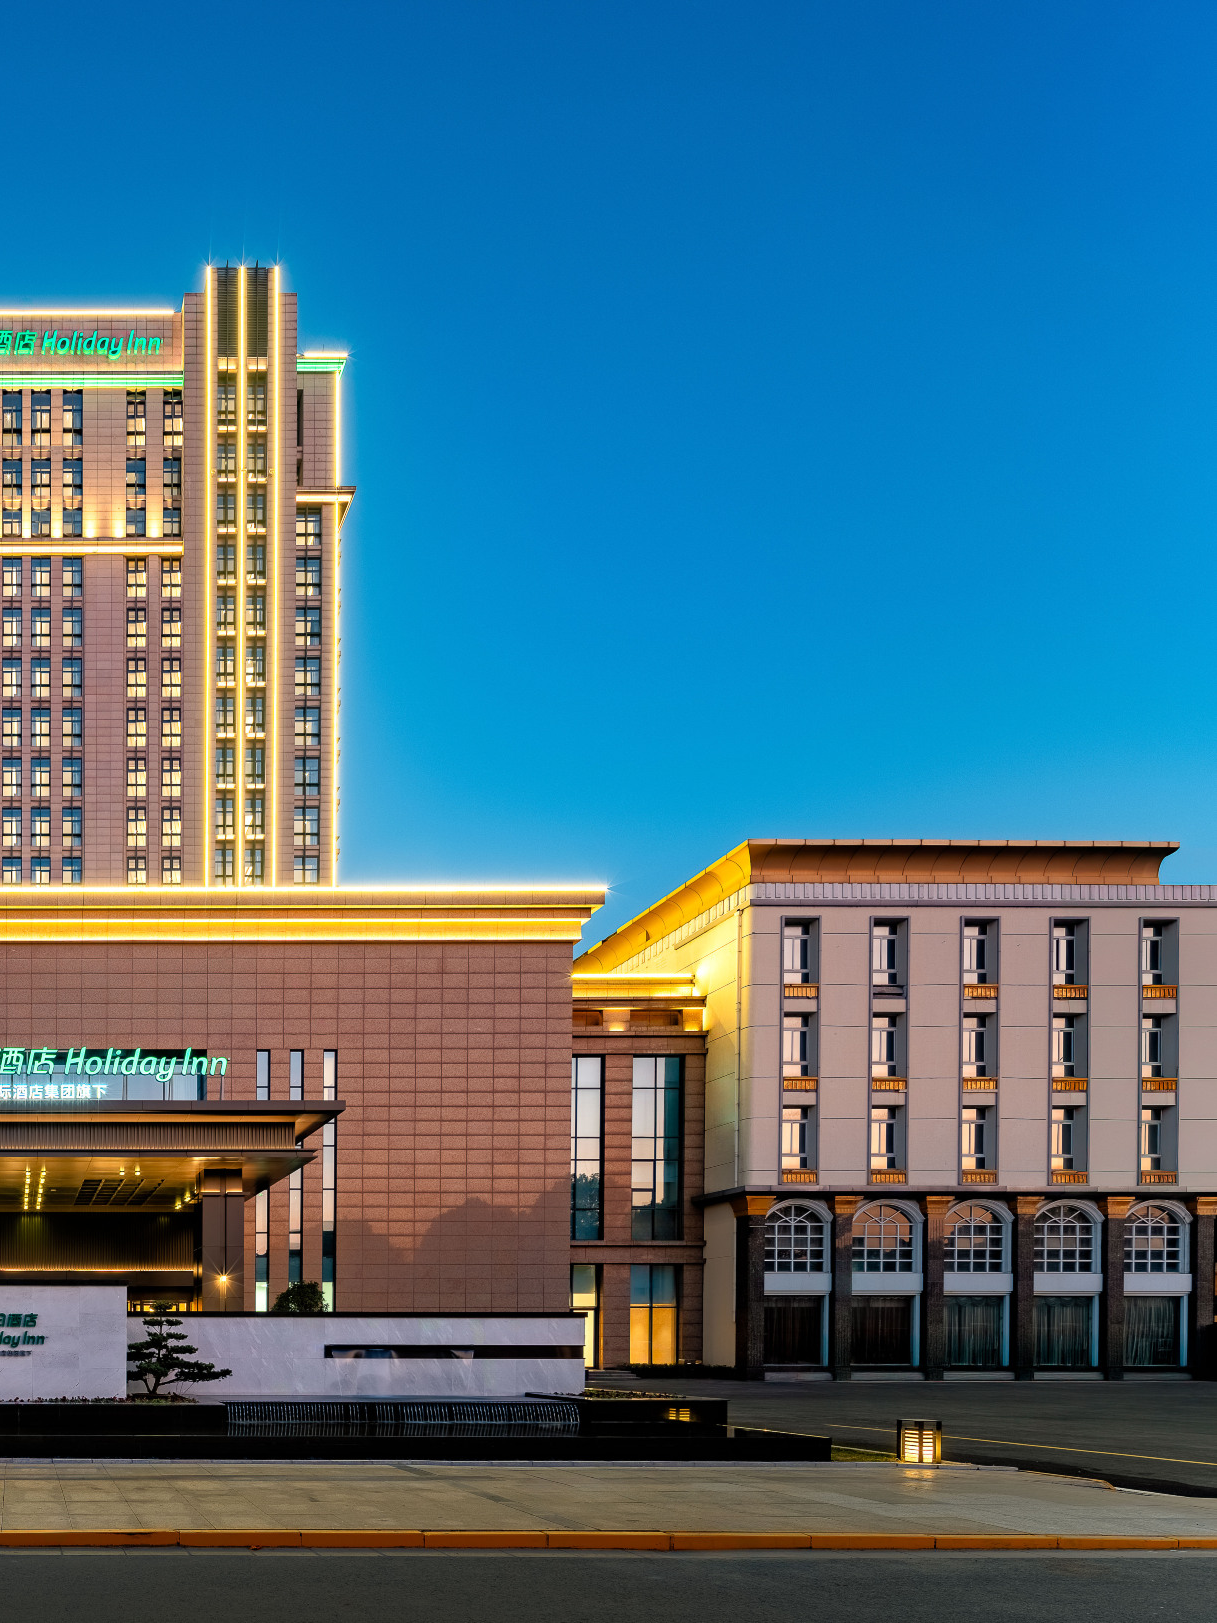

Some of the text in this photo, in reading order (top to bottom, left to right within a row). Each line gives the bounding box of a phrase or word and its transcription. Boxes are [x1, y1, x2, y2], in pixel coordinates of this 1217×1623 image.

[41, 329, 124, 360] Holiday
[127, 329, 162, 356] Inn
[64, 1046, 177, 1082] Holiday
[180, 1046, 229, 1076] Inn
[22, 1330, 46, 1346] Inn
